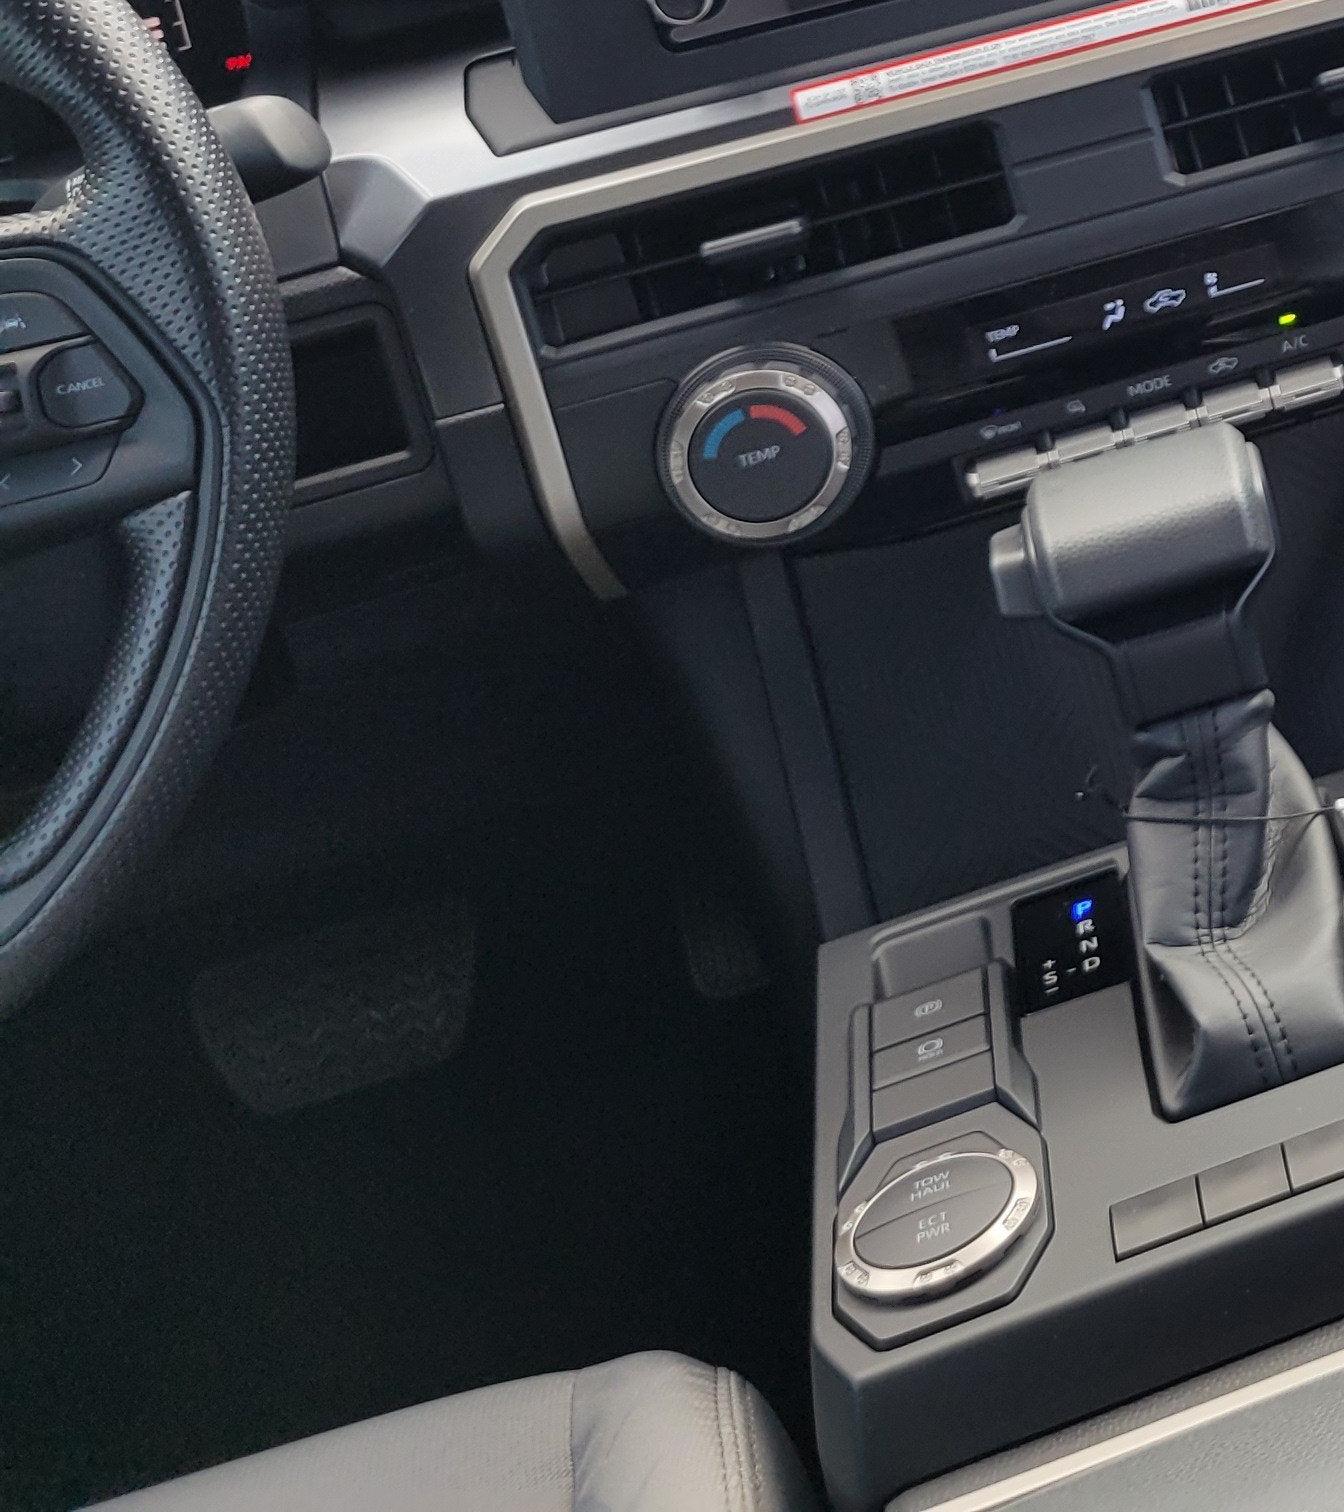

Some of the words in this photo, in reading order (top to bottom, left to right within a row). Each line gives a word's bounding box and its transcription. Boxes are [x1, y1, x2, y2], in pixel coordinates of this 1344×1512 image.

[1282, 334, 1309, 353] A/C
[56, 377, 107, 396] CANCEL
[1126, 374, 1174, 398] MODE
[738, 444, 781, 468] TEMP
[1073, 898, 1094, 921] P
[1076, 918, 1096, 936] R
[1080, 936, 1099, 954] N
[1042, 970, 1058, 986] S
[1083, 956, 1101, 973] D
[910, 1180, 951, 1203] HAUL
[914, 1170, 951, 1190] TOW
[916, 1221, 951, 1244] PWR
